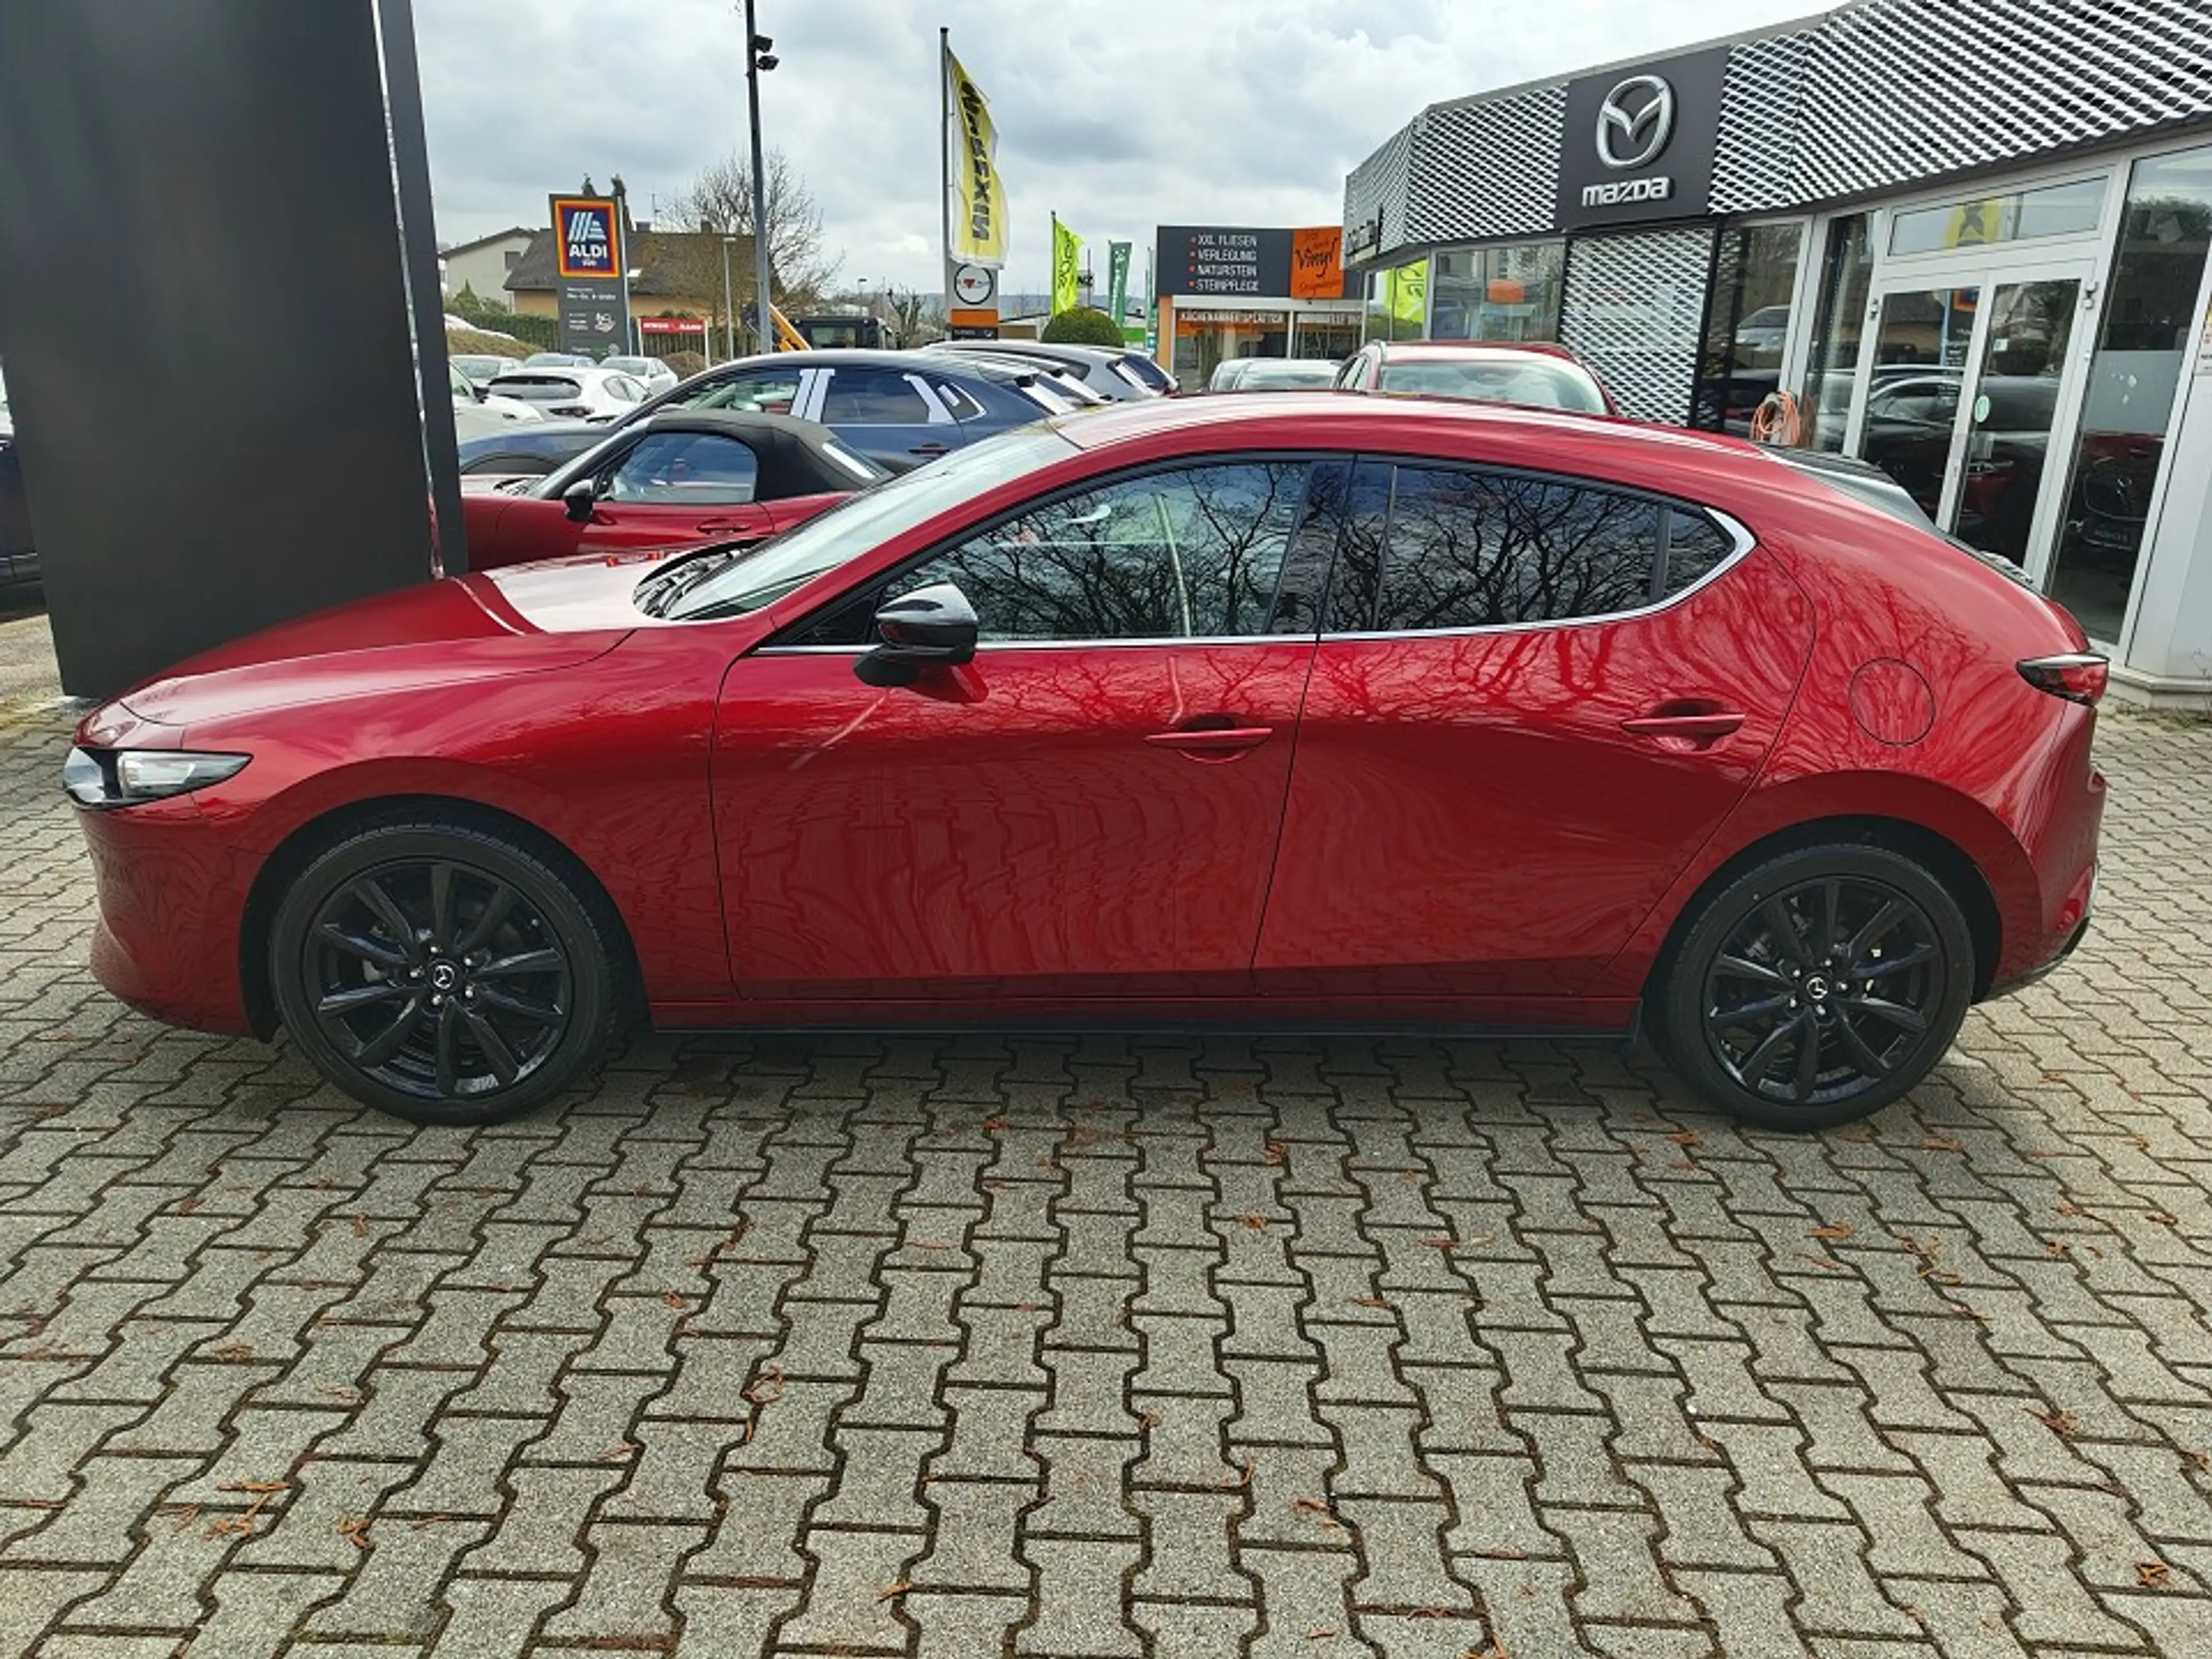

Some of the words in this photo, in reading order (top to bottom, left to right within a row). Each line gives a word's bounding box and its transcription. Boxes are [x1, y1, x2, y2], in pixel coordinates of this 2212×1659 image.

[1198, 234, 1215, 245] XXL
[1218, 235, 1257, 247] FLIESEN
[569, 244, 608, 259] ALDI
[1198, 248, 1257, 262] VERLEGUNG
[1198, 264, 1257, 277] NATURSTEIN
[1196, 278, 1259, 291] STEINPFLEGE
